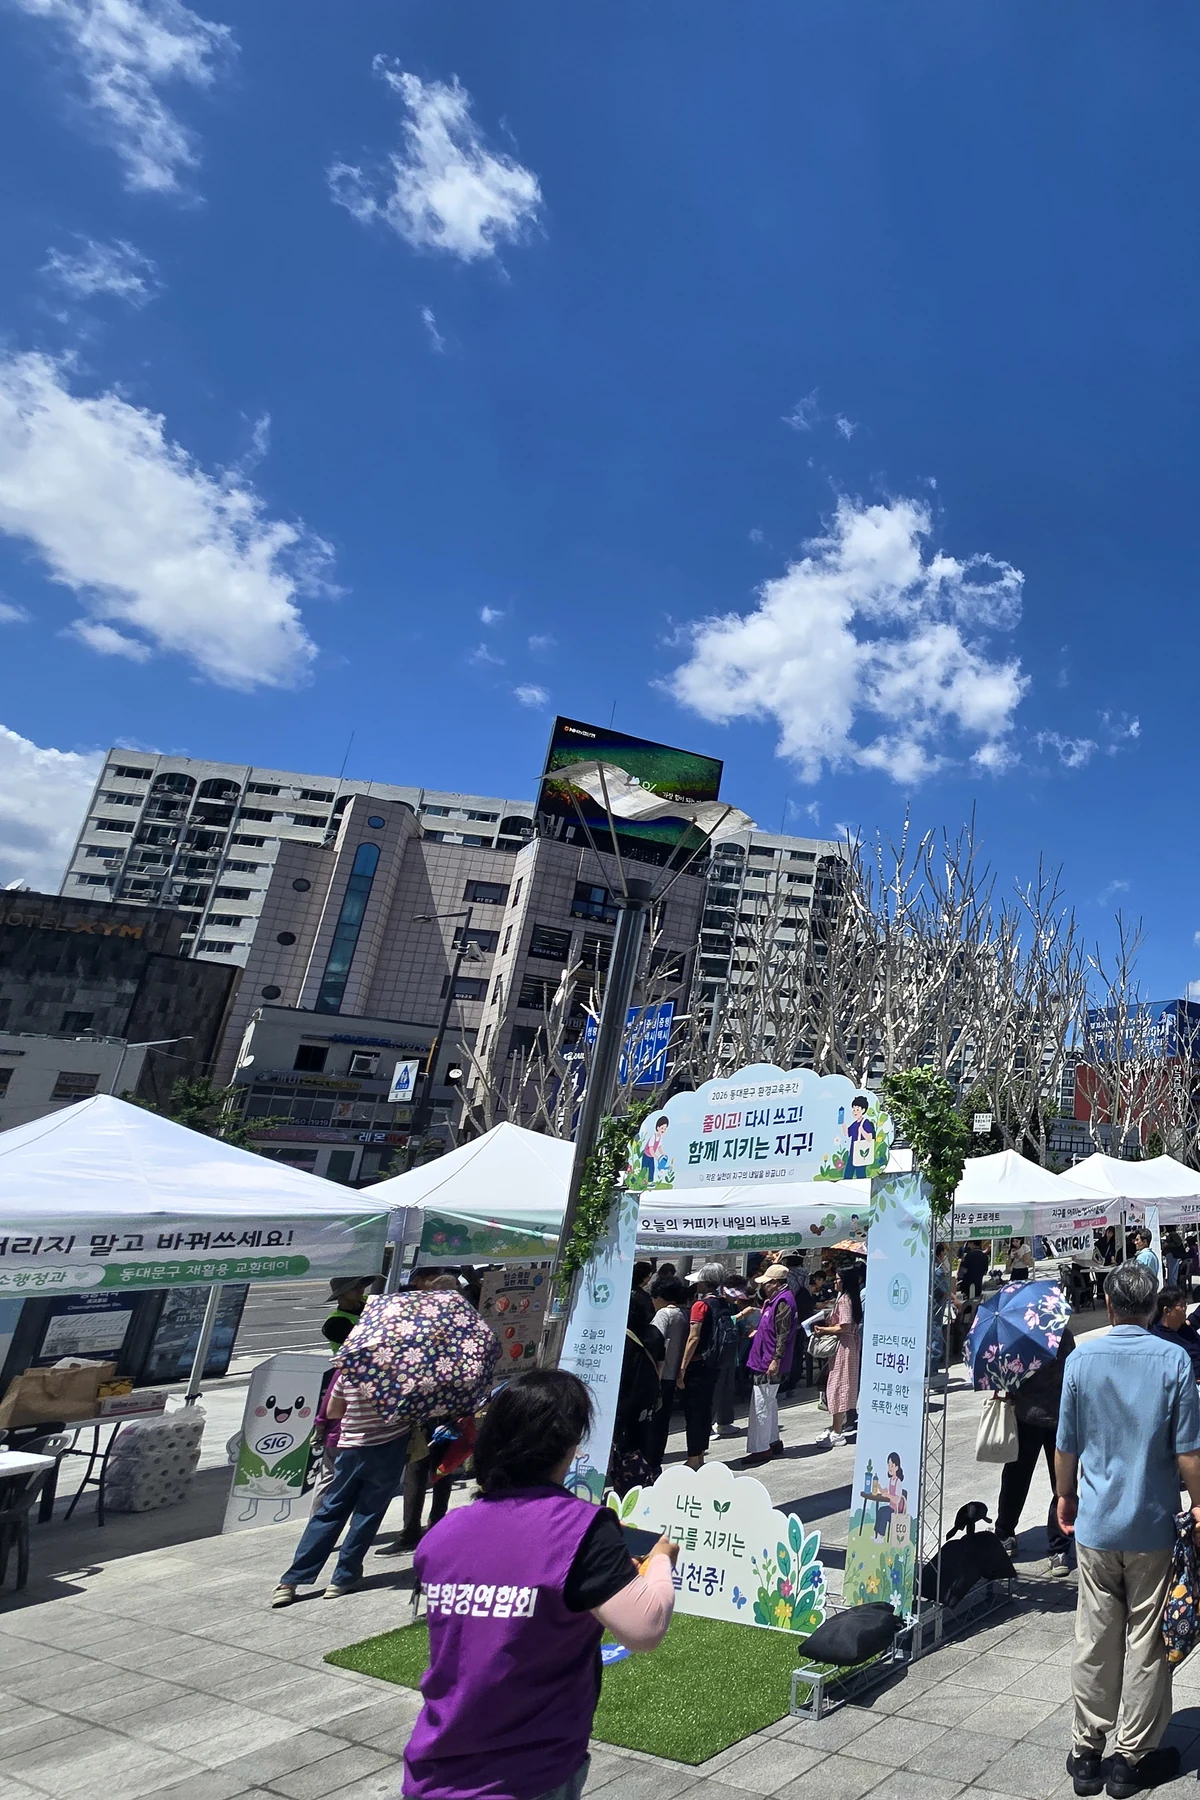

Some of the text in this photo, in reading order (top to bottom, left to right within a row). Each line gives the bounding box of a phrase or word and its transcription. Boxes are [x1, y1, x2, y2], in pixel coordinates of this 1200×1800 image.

[712, 1083, 799, 1101] 2026 동대문구 환경교육주간
[703, 1106, 804, 1133] 줄이고! 다시 쓰고!
[688, 1132, 814, 1164] 함께 지키는 지구!
[732, 1171, 748, 1180] 지구의
[764, 1169, 786, 1178] 바꿉니다
[976, 1212, 1001, 1222] 프로젝트
[1052, 1208, 1066, 1218] 지구를
[641, 1215, 791, 1232] 오늘의 커피가 내일의 비누로
[90, 1233, 144, 1256] 말고
[157, 1230, 294, 1251] 바꿔쓰세요!
[119, 1264, 181, 1281] 동대문구
[187, 1262, 230, 1278] 재활용
[235, 1260, 289, 1274] 교환데이
[581, 1329, 606, 1339] 오늘의
[871, 1334, 916, 1349] 플라스틱 대신
[589, 1344, 613, 1354] 실천이
[576, 1358, 601, 1368] 지구의
[876, 1352, 909, 1373] 다회용!
[872, 1382, 910, 1398] 지구를 위한
[871, 1399, 909, 1417] 똑똑한 선택
[261, 1436, 288, 1450] SIG
[677, 1494, 703, 1518] 나는
[703, 1530, 746, 1558] 지키는
